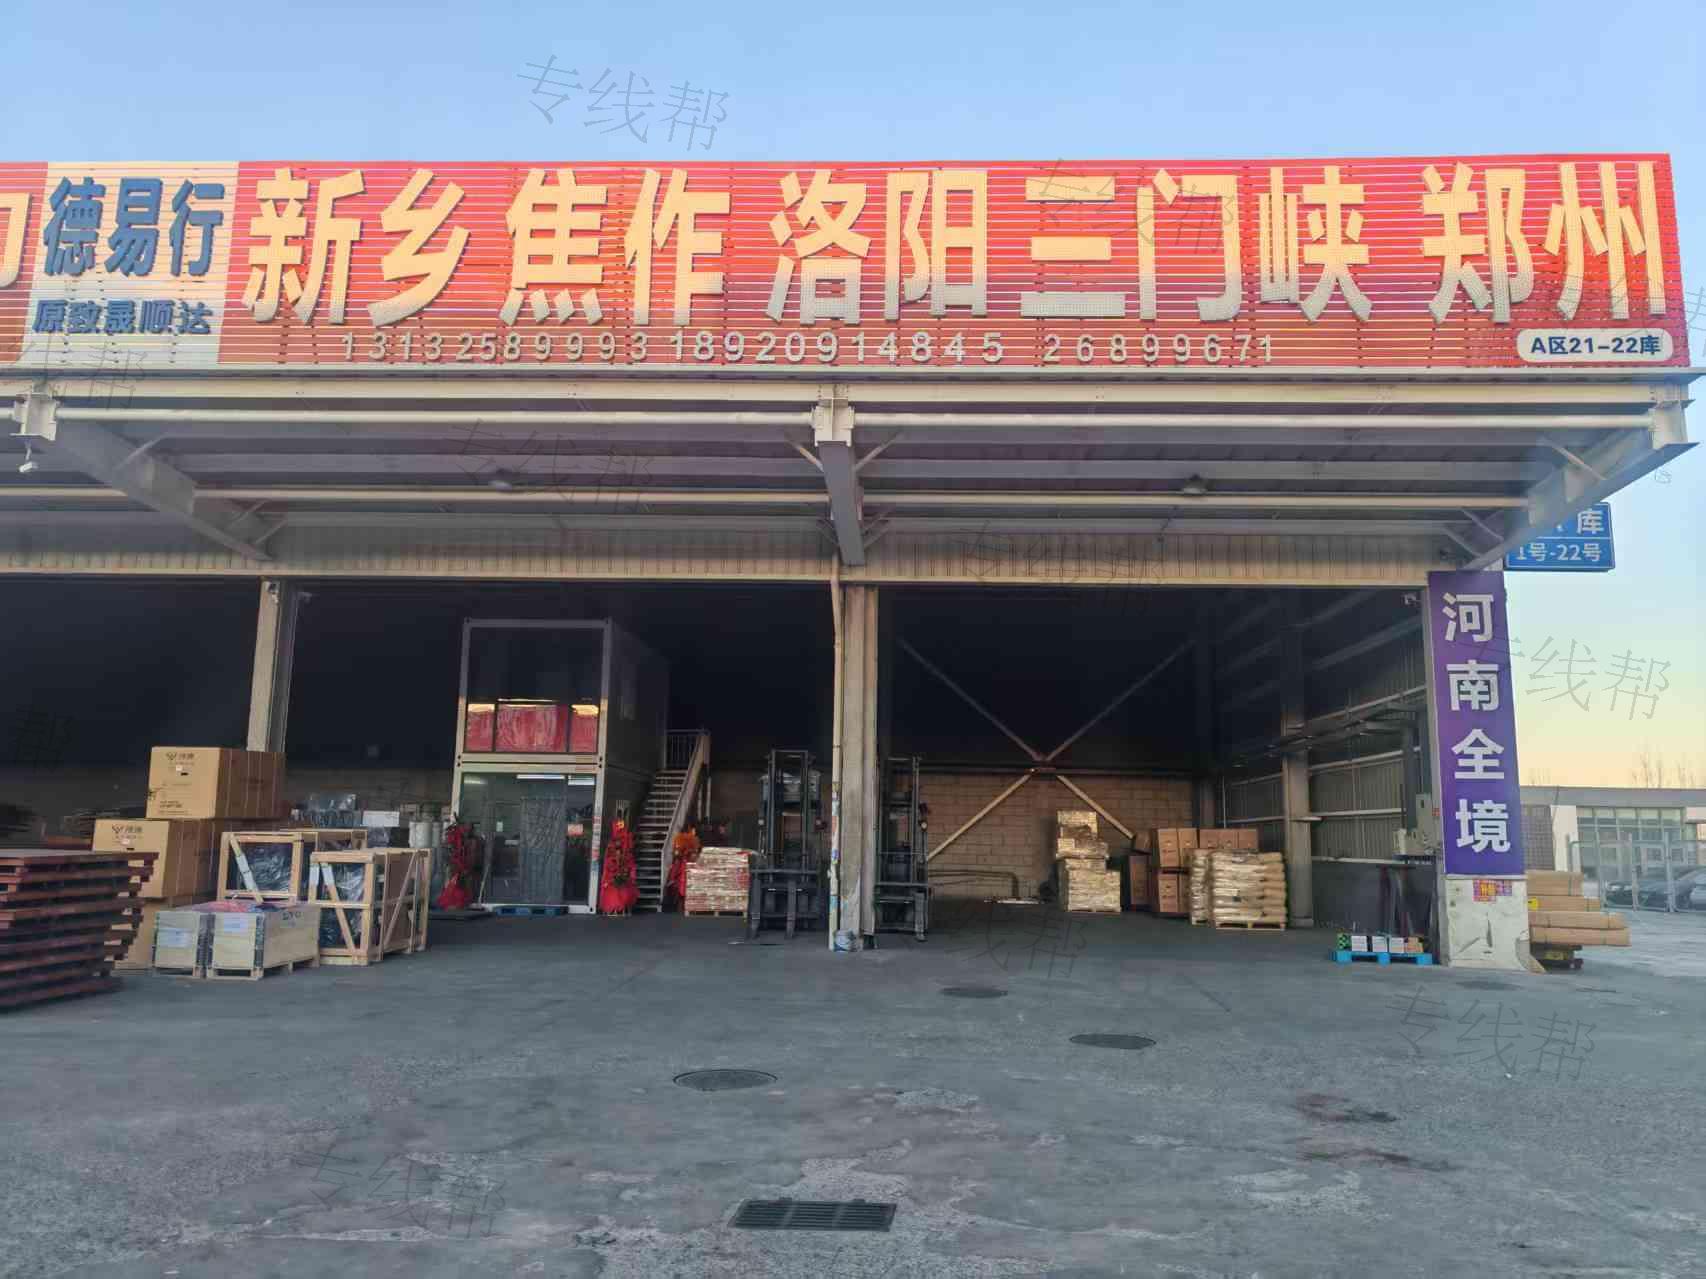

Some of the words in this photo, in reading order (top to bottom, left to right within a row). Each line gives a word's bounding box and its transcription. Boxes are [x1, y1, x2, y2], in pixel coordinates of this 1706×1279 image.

[44, 176, 225, 277] 德易行
[242, 168, 469, 326] 新乡
[501, 168, 731, 326] 焦作
[766, 169, 988, 326] 洛阳
[1021, 165, 1372, 324] 三门峡
[1421, 161, 1666, 324] 郑州
[341, 331, 648, 362] 13132589993
[670, 331, 1004, 363] 18920914845
[1042, 333, 1273, 363] 26899671
[1442, 592, 1511, 853] 河南全境
